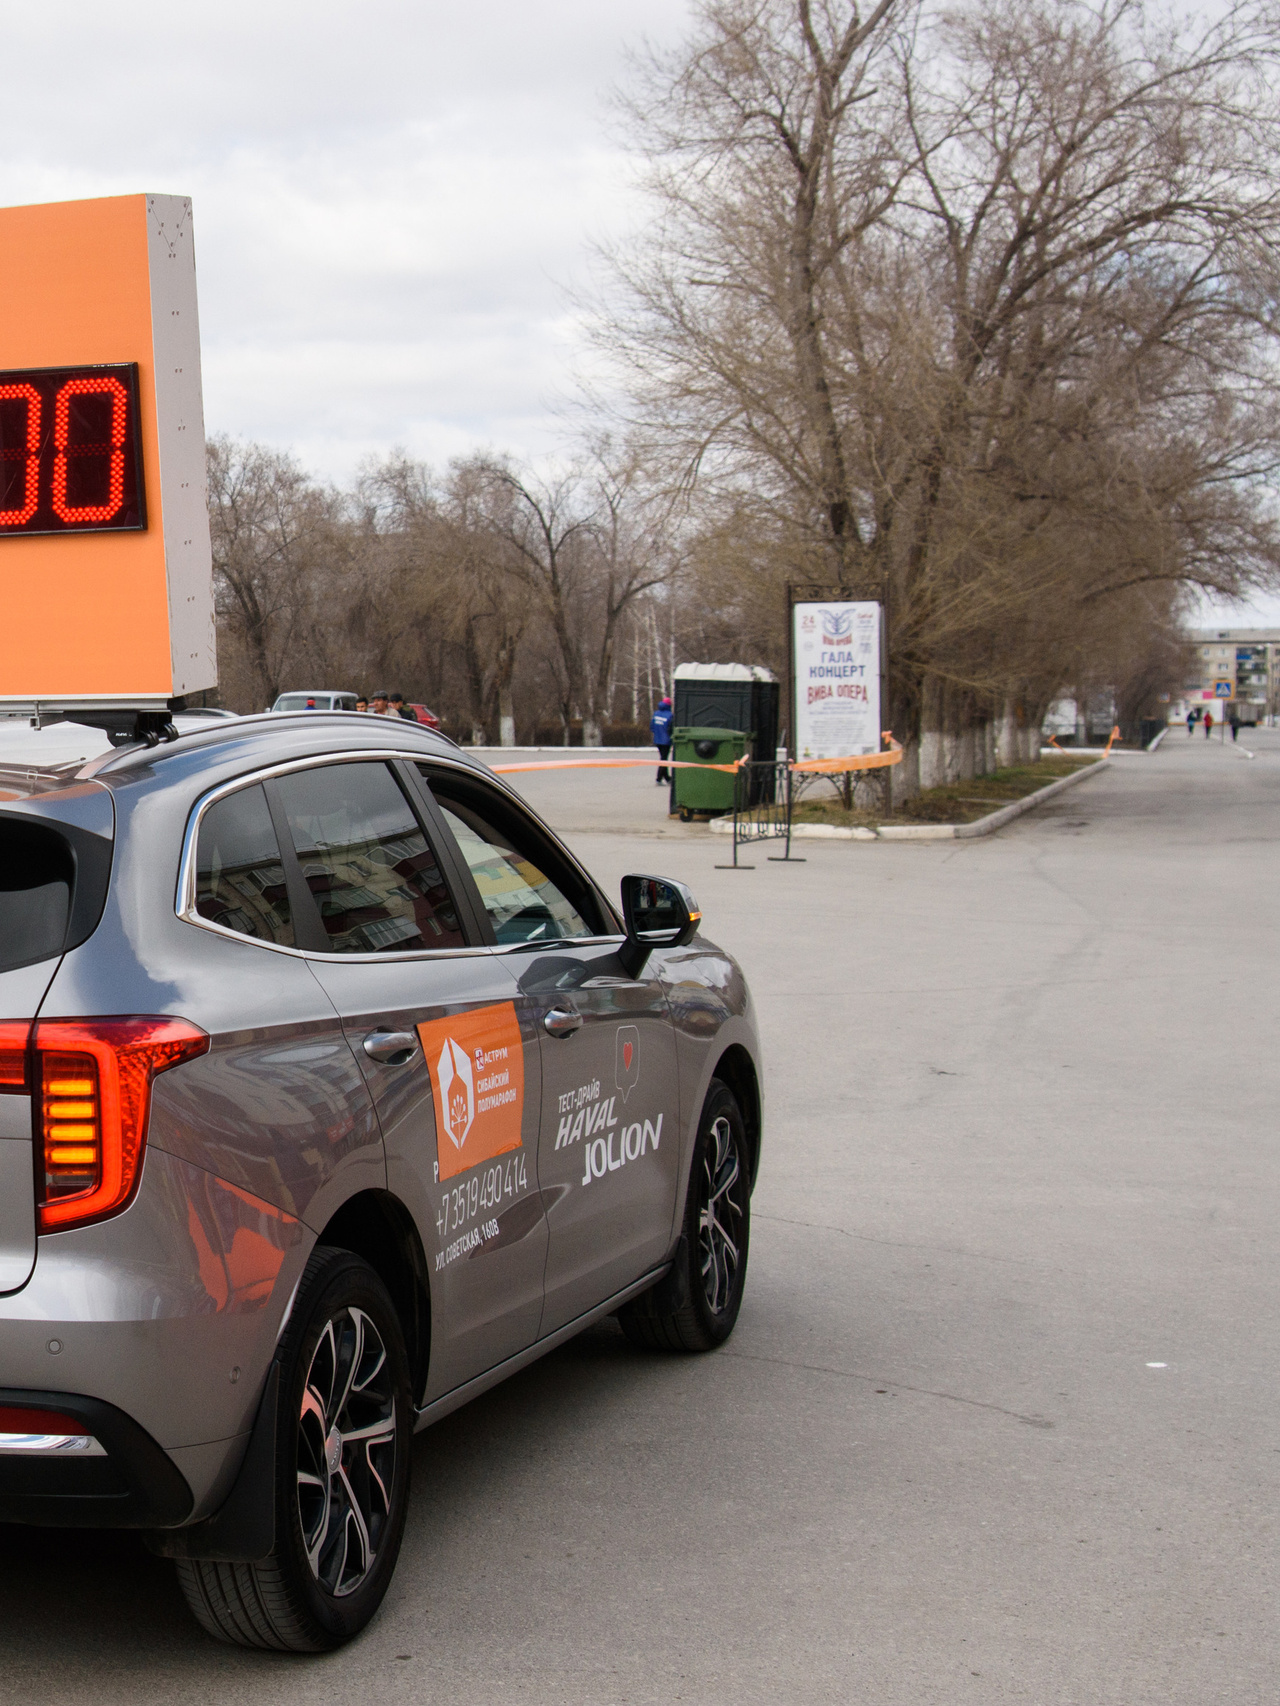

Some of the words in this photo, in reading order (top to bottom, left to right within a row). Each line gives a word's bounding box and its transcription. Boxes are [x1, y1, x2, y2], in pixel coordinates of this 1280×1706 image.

[821, 652, 854, 663] ГАЛА
[809, 665, 866, 679] КОНЦЕРТ
[807, 686, 833, 705] ВИВА
[837, 685, 869, 704] ОПЕРА
[484, 1046, 509, 1064] АСТРУМ
[477, 1068, 510, 1094] СИБАЙСКИЙ
[477, 1087, 517, 1114] ПОЛУМАРАФОН
[558, 1077, 601, 1114] ТЕСТ-ДРАЙВ
[554, 1096, 618, 1151] HAVAL
[581, 1113, 664, 1187] JOLION
